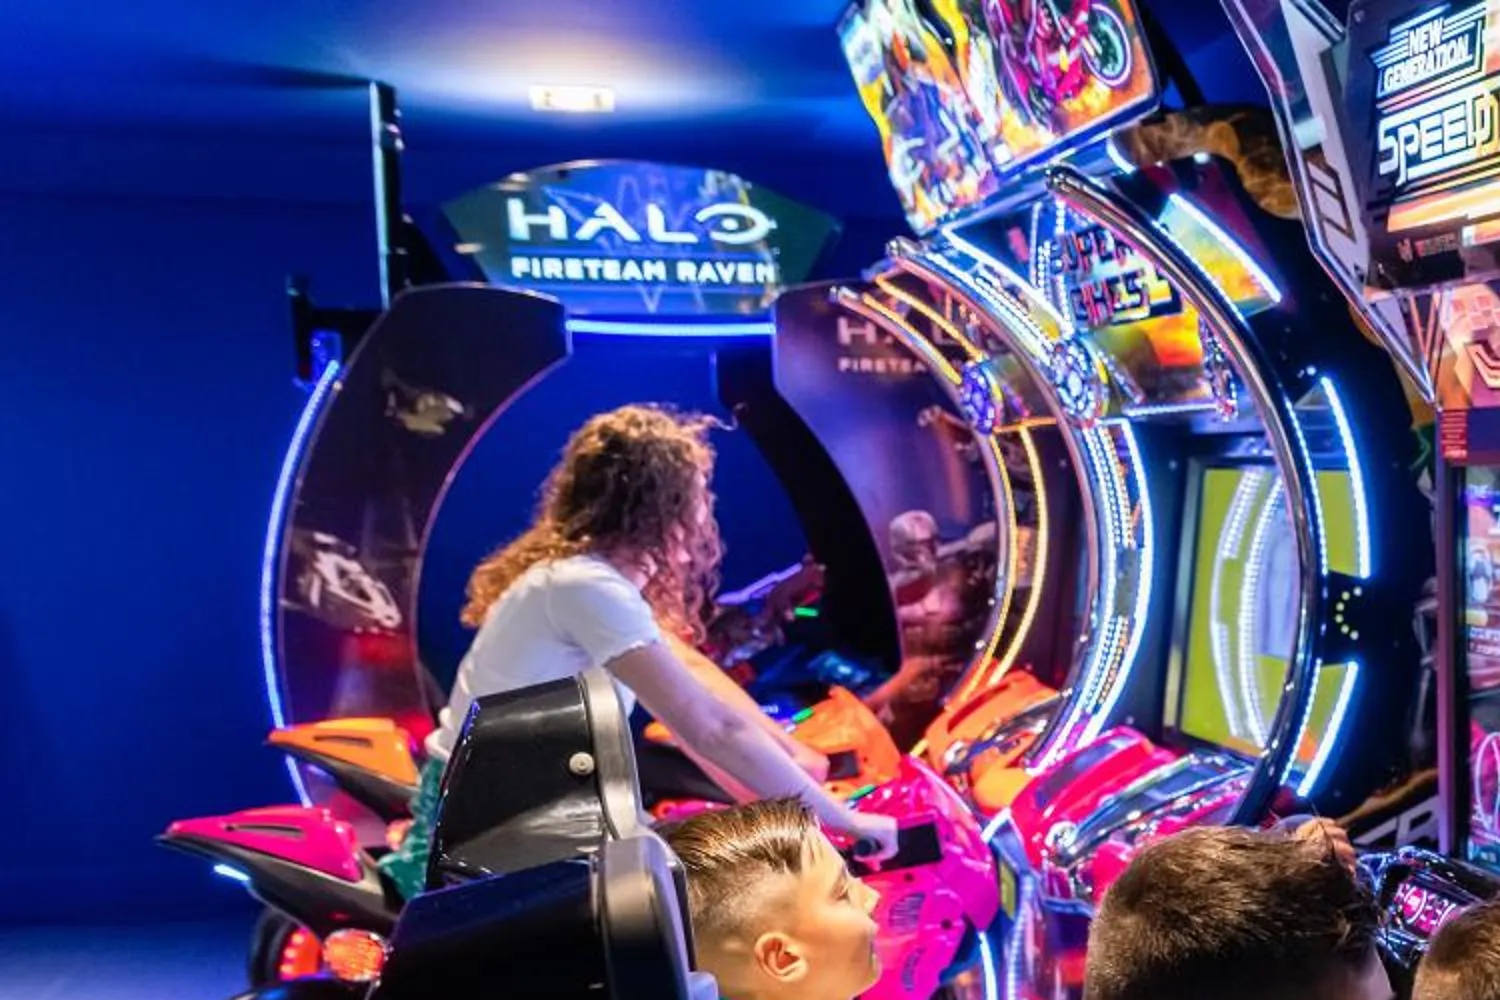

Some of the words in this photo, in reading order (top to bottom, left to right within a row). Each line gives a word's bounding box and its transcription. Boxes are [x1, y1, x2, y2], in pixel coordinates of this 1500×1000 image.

[1407, 17, 1444, 57] NEW
[1383, 33, 1472, 92] GENERATION
[507, 197, 777, 245] HALO
[510, 255, 667, 281] FIRETEAM
[676, 261, 776, 284] RAVEN
[837, 356, 929, 374] FIRETEA
